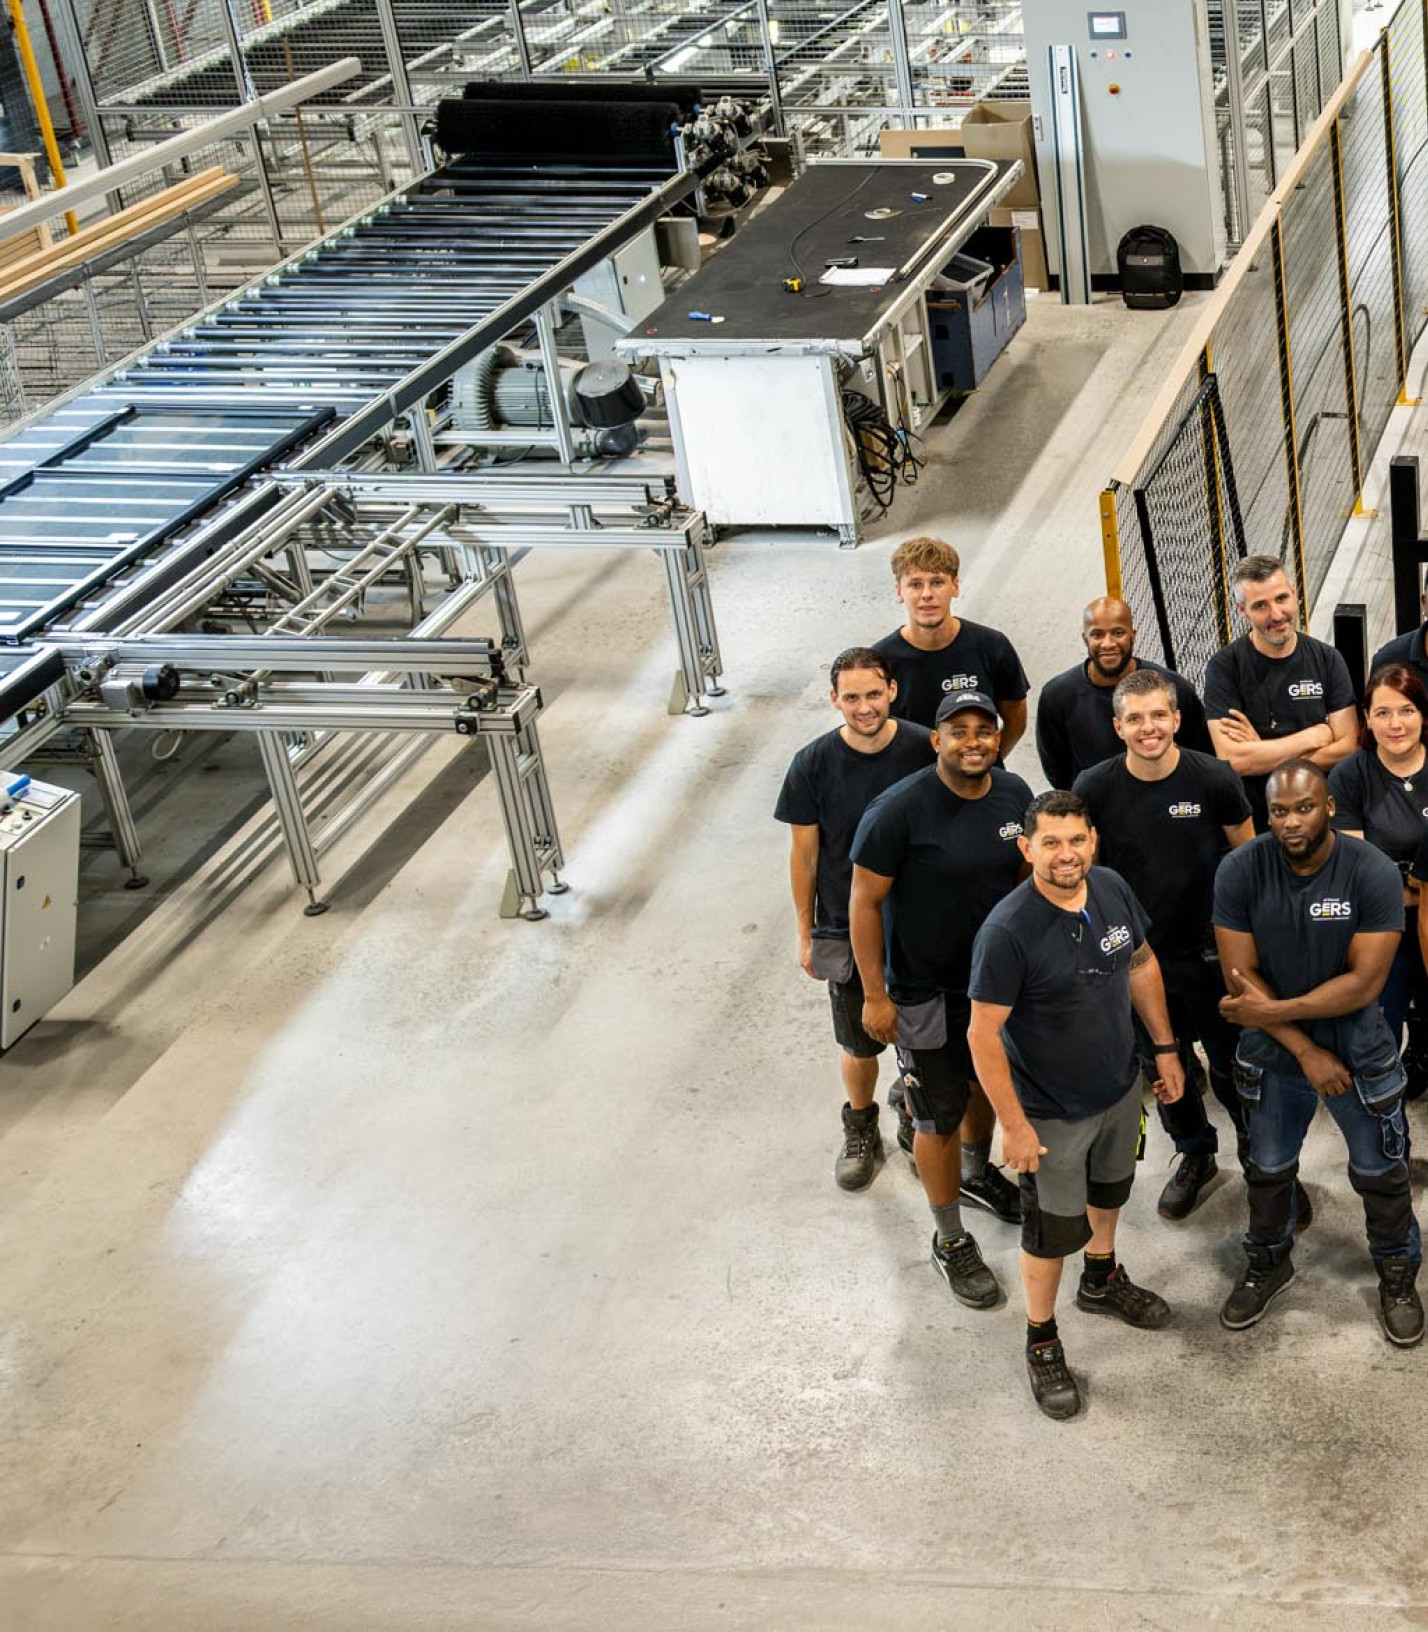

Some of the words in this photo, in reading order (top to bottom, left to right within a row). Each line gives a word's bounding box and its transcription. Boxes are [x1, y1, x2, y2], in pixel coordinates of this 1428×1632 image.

[942, 675, 979, 691] GERS
[1289, 682, 1324, 697] GERS
[1169, 803, 1201, 816] GERS
[1310, 901, 1351, 917] GERS
[1100, 925, 1130, 952] GERS
